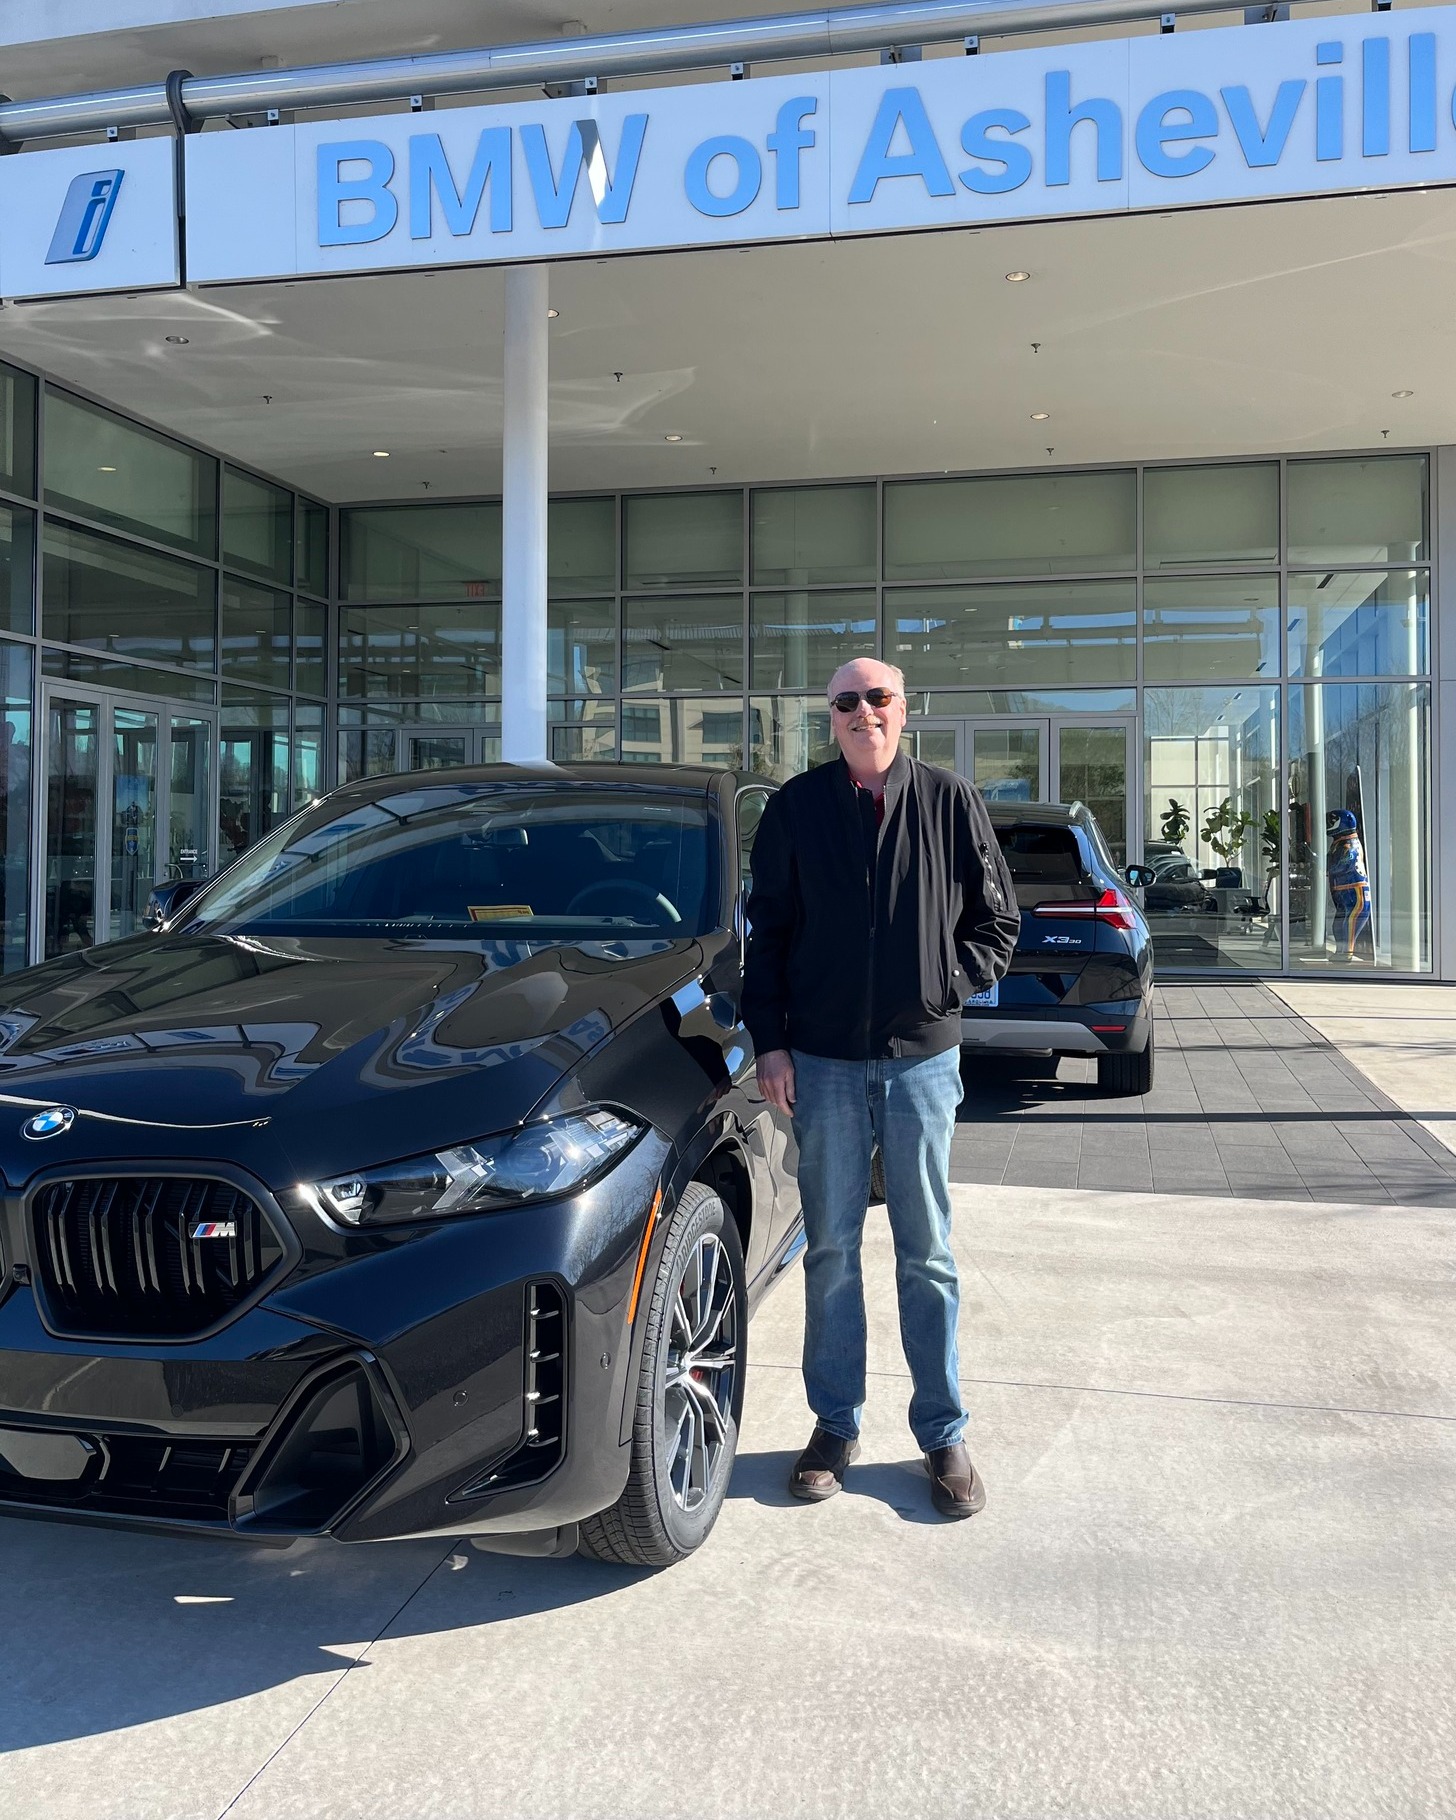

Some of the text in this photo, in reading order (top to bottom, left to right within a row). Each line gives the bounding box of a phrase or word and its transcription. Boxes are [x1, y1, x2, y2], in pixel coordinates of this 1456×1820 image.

[317, 32, 1456, 247] BMW of Ashevill
